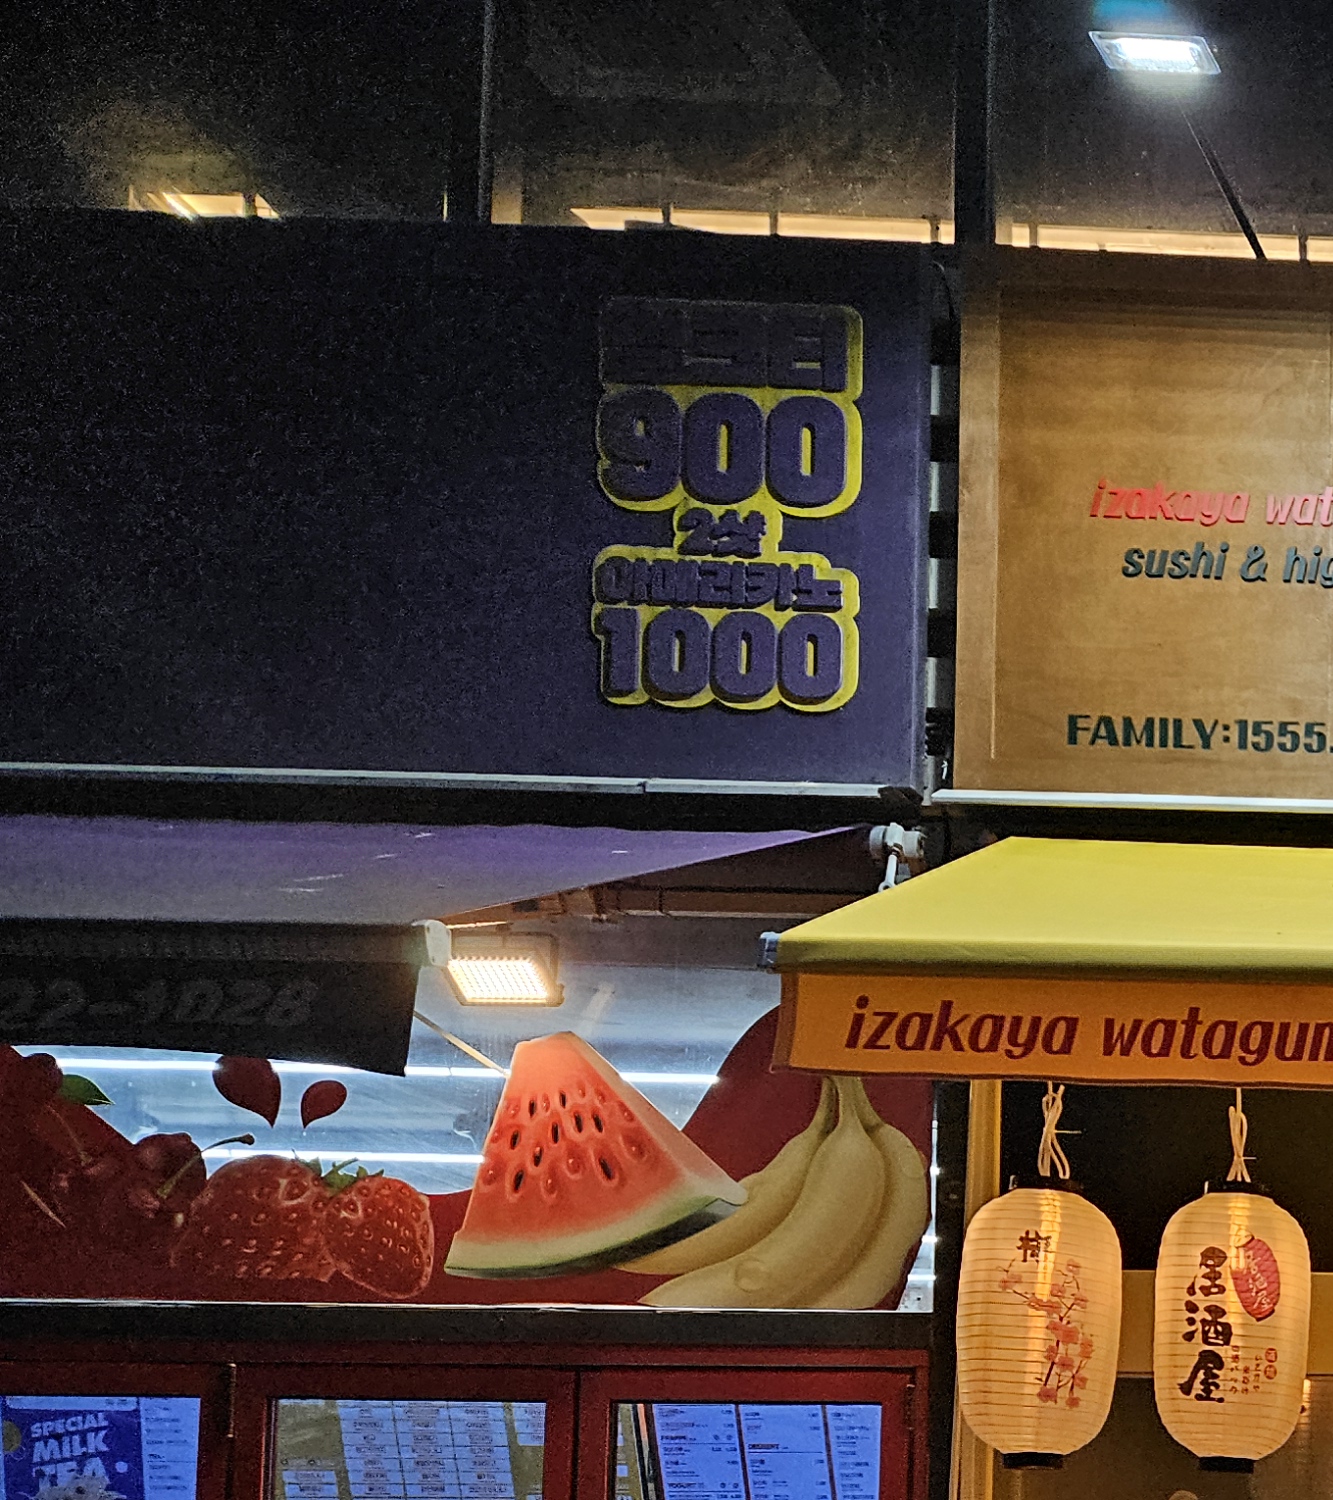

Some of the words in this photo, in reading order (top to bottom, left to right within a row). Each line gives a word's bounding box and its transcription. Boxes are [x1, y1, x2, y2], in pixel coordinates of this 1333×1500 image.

[600, 390, 847, 505] 900
[1088, 480, 1252, 527] izakaya
[600, 557, 845, 610] 아메리카노
[1121, 541, 1230, 582] sushi
[1239, 544, 1270, 584] &
[600, 606, 845, 703] 1000
[844, 995, 1080, 1060] izakaya
[30, 1412, 109, 1438] SPECIAL
[33, 1430, 111, 1464] MILK
